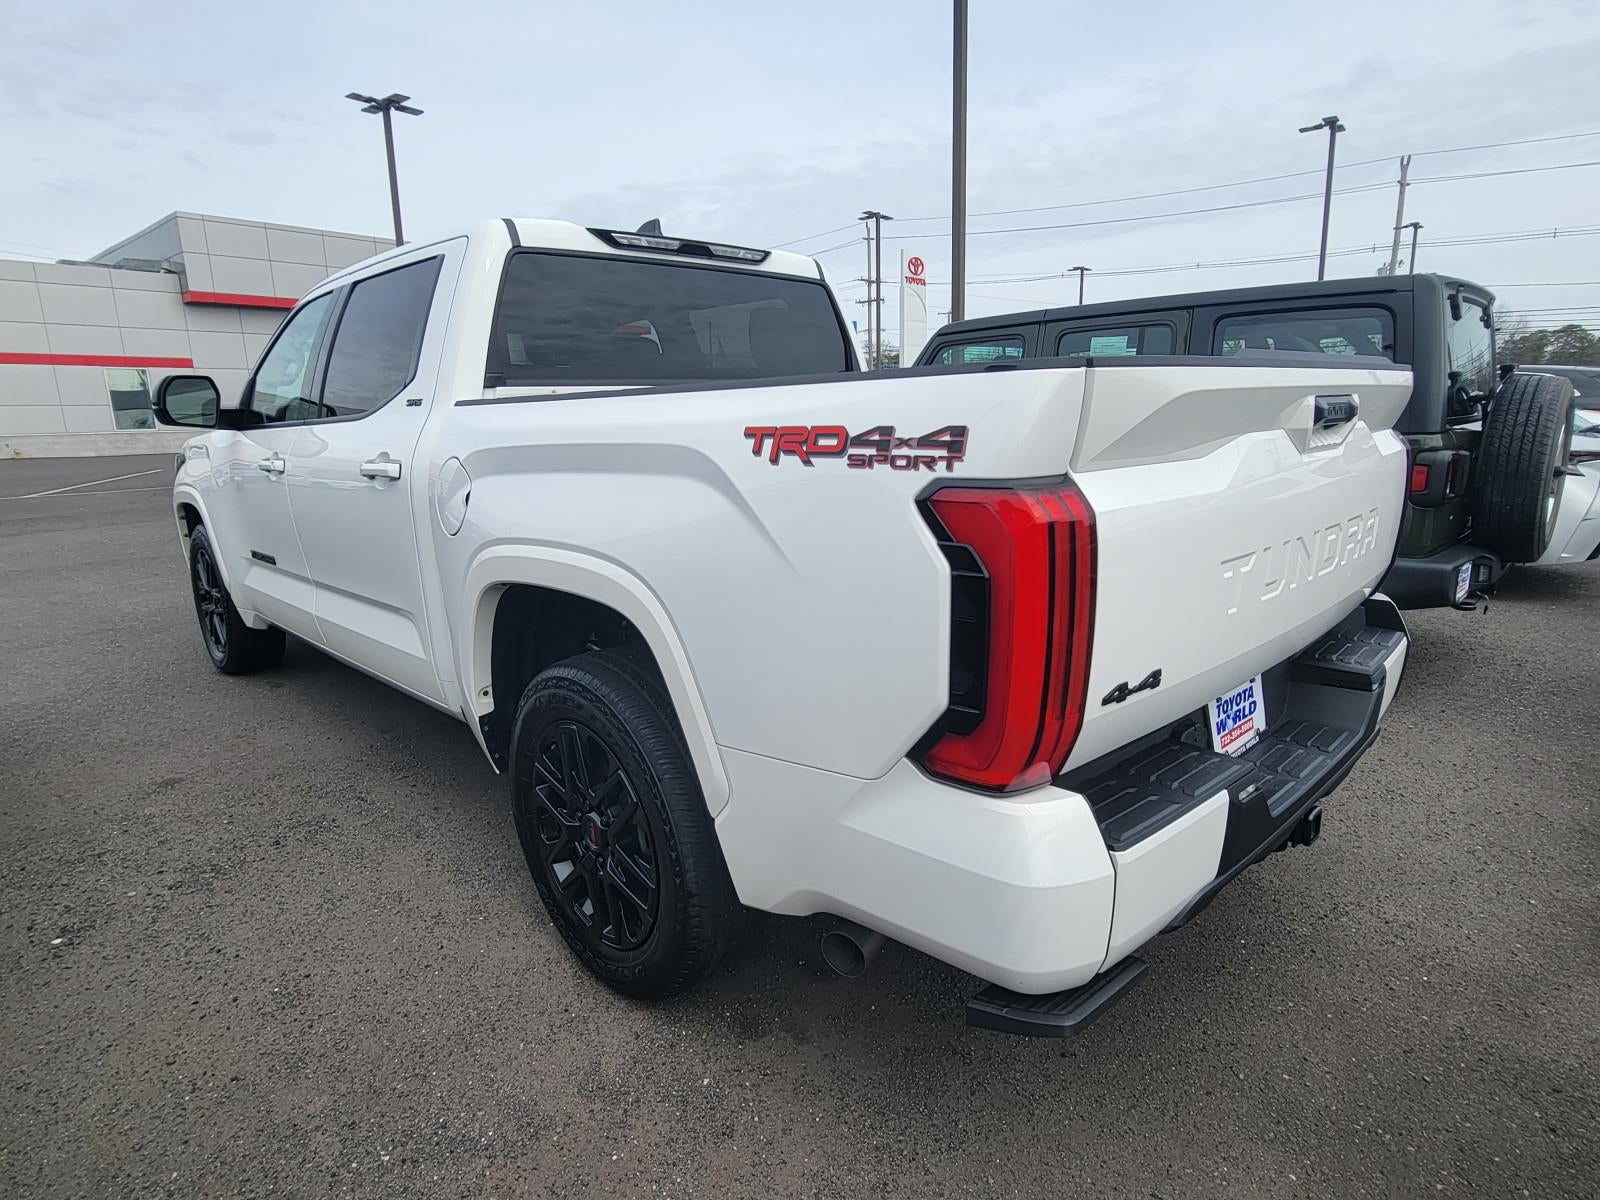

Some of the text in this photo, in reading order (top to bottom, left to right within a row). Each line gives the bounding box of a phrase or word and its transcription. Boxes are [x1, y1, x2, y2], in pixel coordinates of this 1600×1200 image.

[905, 276, 926, 286] TOYOTA
[744, 425, 969, 468] TRD 4x4
[846, 453, 964, 473] SPORT
[1220, 507, 1380, 615] TUNDRA
[1101, 668, 1162, 706] 4x4
[1216, 685, 1254, 719] TOYOTA
[1216, 700, 1257, 736] WORLD
